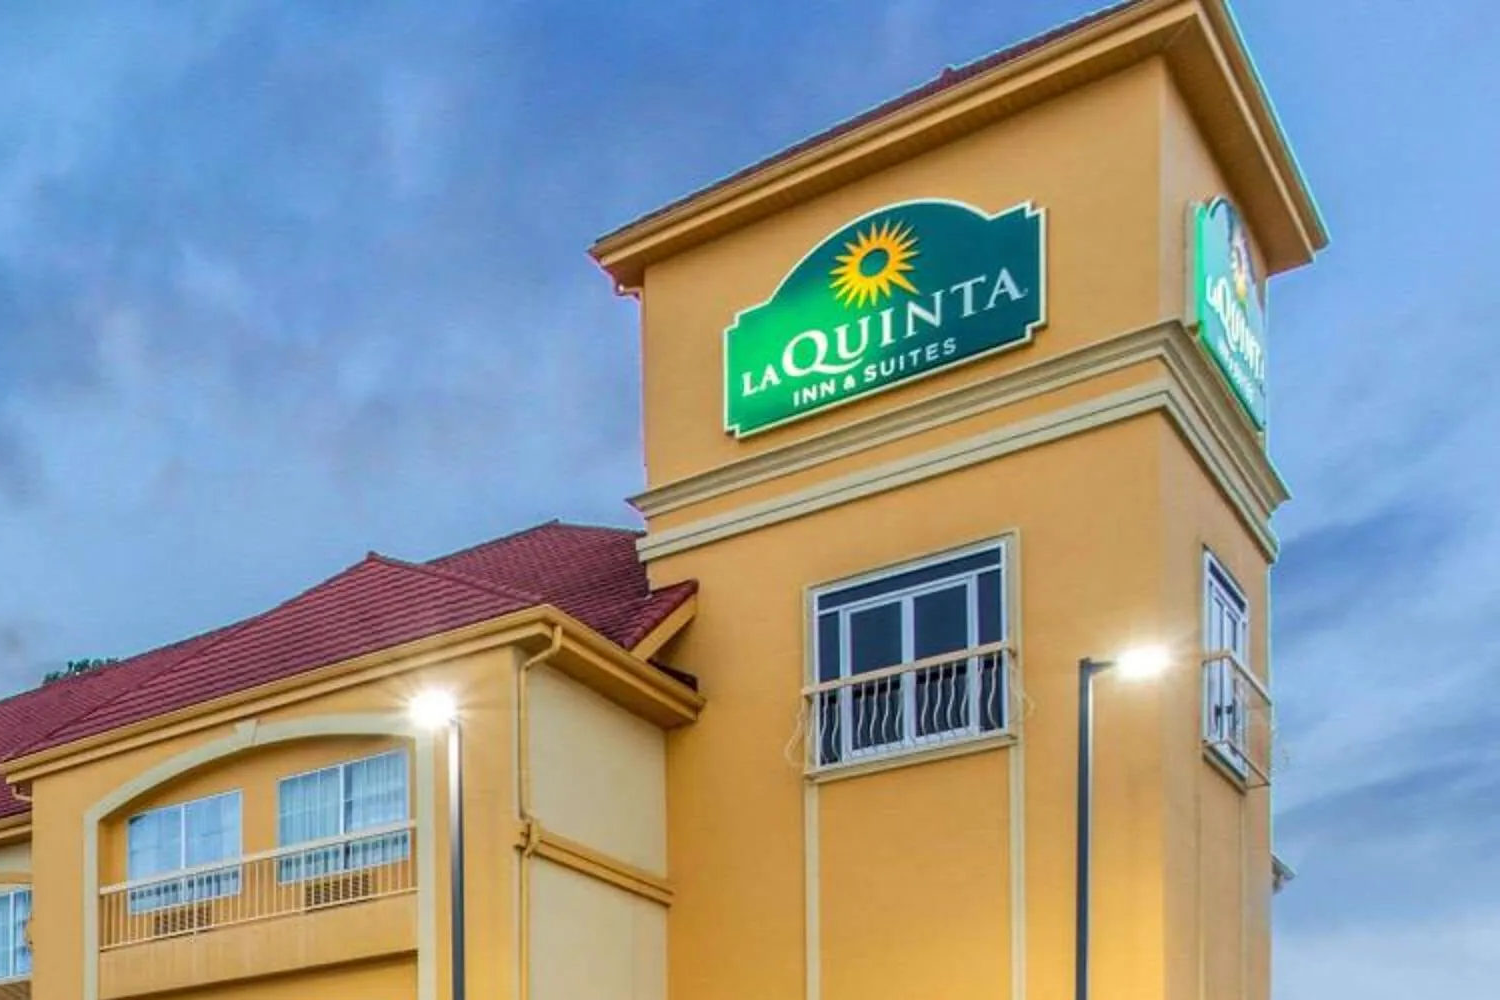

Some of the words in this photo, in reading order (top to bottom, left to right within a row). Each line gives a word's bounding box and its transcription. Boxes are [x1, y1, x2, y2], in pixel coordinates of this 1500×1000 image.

[741, 362, 782, 397] LA
[781, 266, 1025, 377] QUINTA
[792, 379, 837, 407] INN
[863, 336, 957, 382] SUITES
